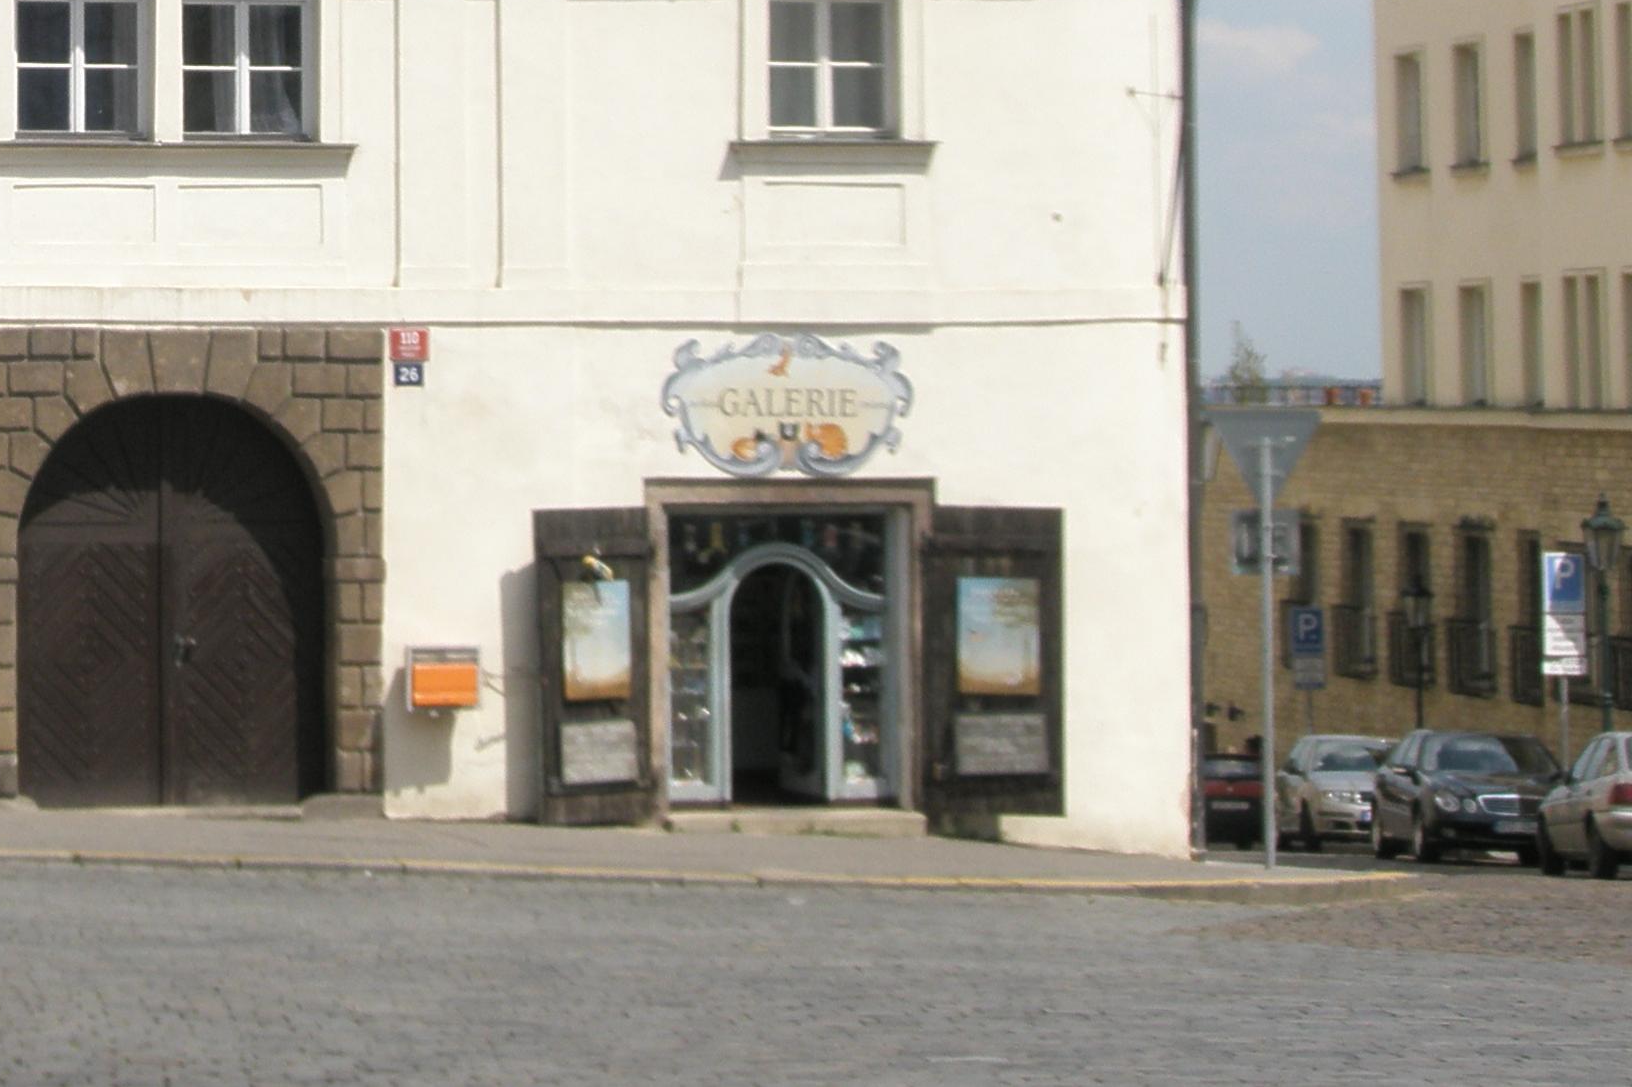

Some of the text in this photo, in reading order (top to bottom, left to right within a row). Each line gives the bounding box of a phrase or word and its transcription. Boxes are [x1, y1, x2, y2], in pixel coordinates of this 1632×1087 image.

[400, 367, 419, 382] 26
[720, 388, 858, 417] GALERIE
[1555, 558, 1575, 589] P
[1299, 614, 1317, 640] P
